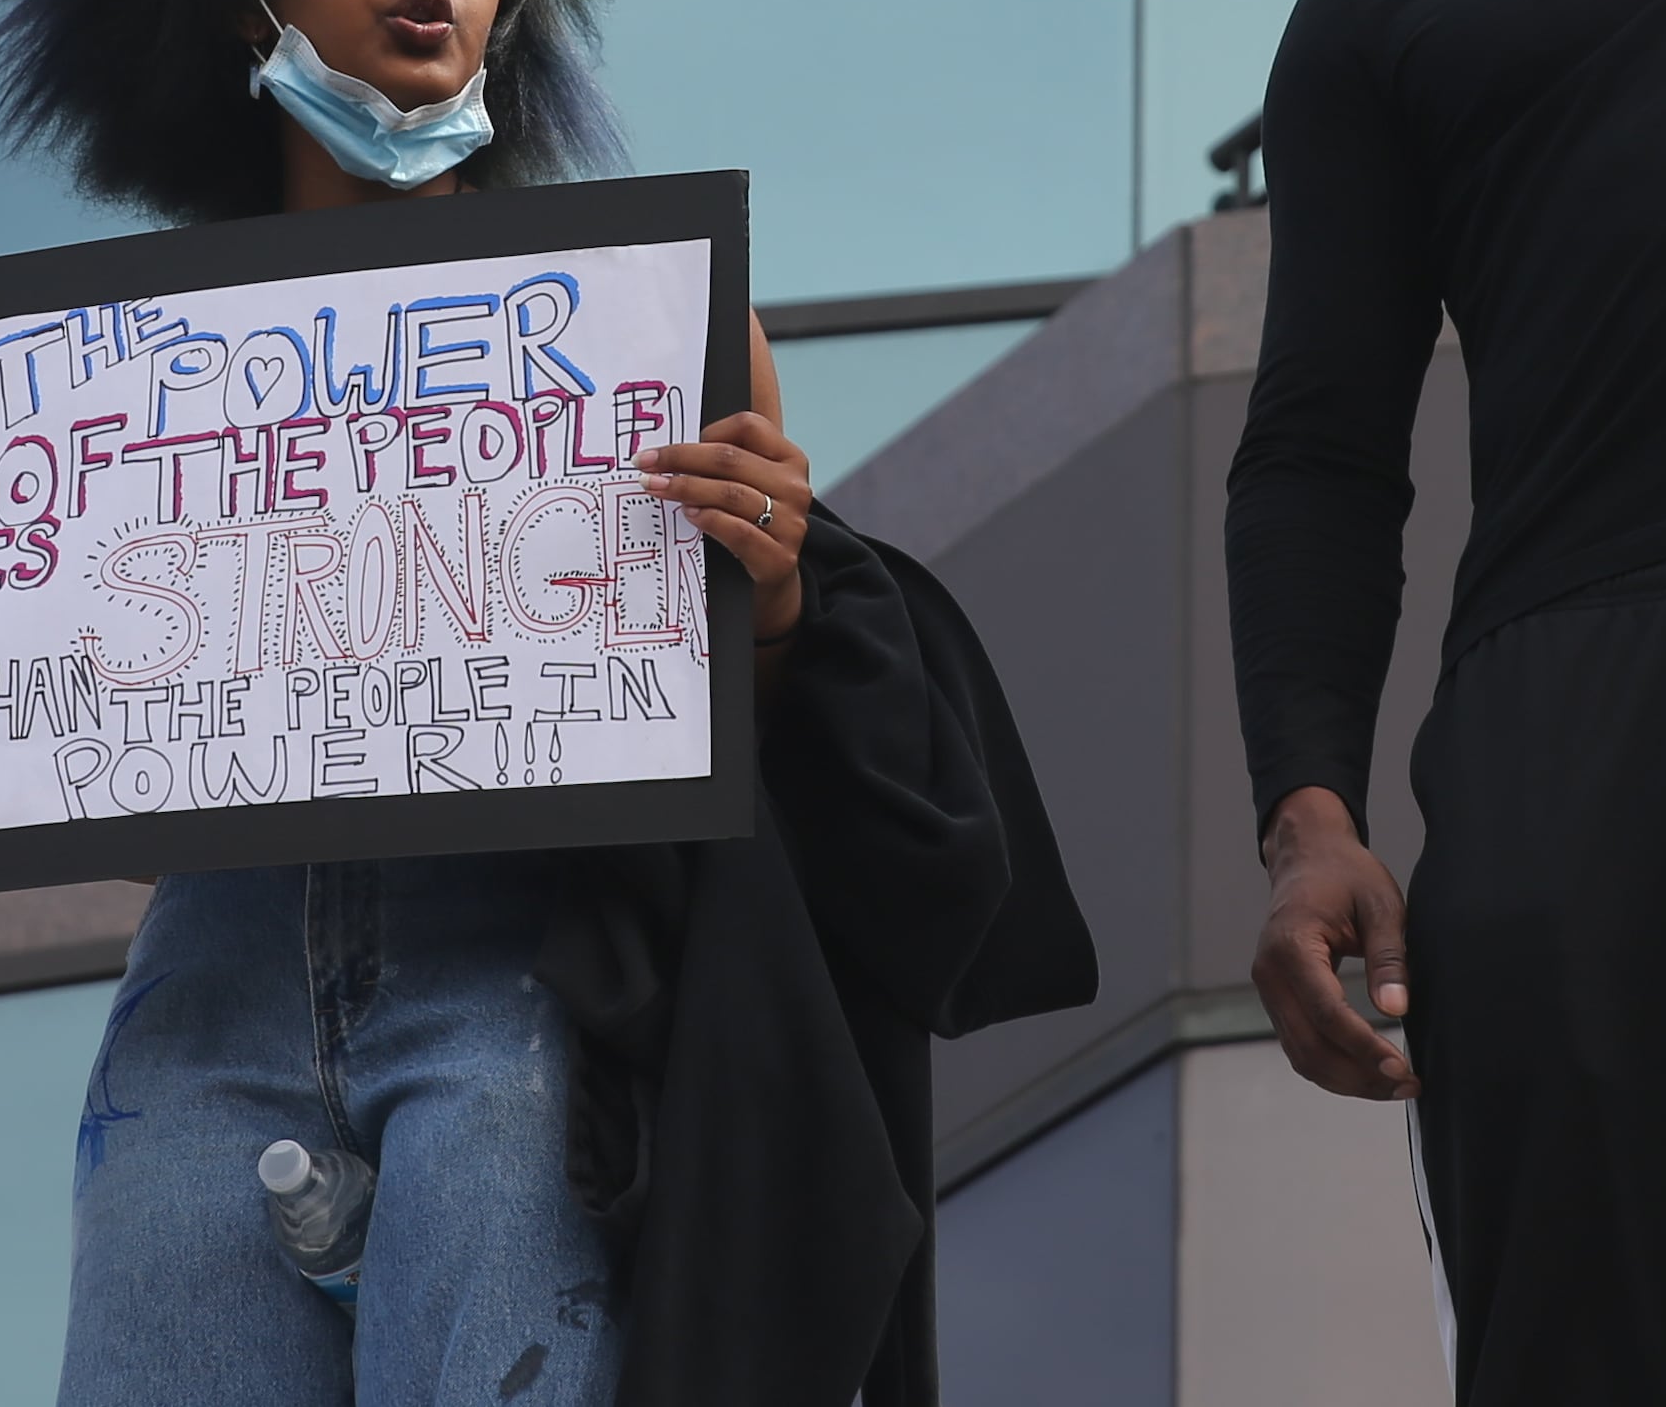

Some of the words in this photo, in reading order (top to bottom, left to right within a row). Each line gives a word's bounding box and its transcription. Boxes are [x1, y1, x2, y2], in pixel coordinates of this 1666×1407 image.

[149, 272, 594, 437] POWER
[122, 417, 329, 523] THE
[109, 675, 252, 744] THE
[287, 656, 512, 731] PEOPLE
[535, 659, 675, 724] IN
[55, 722, 563, 820] POWER!!!
